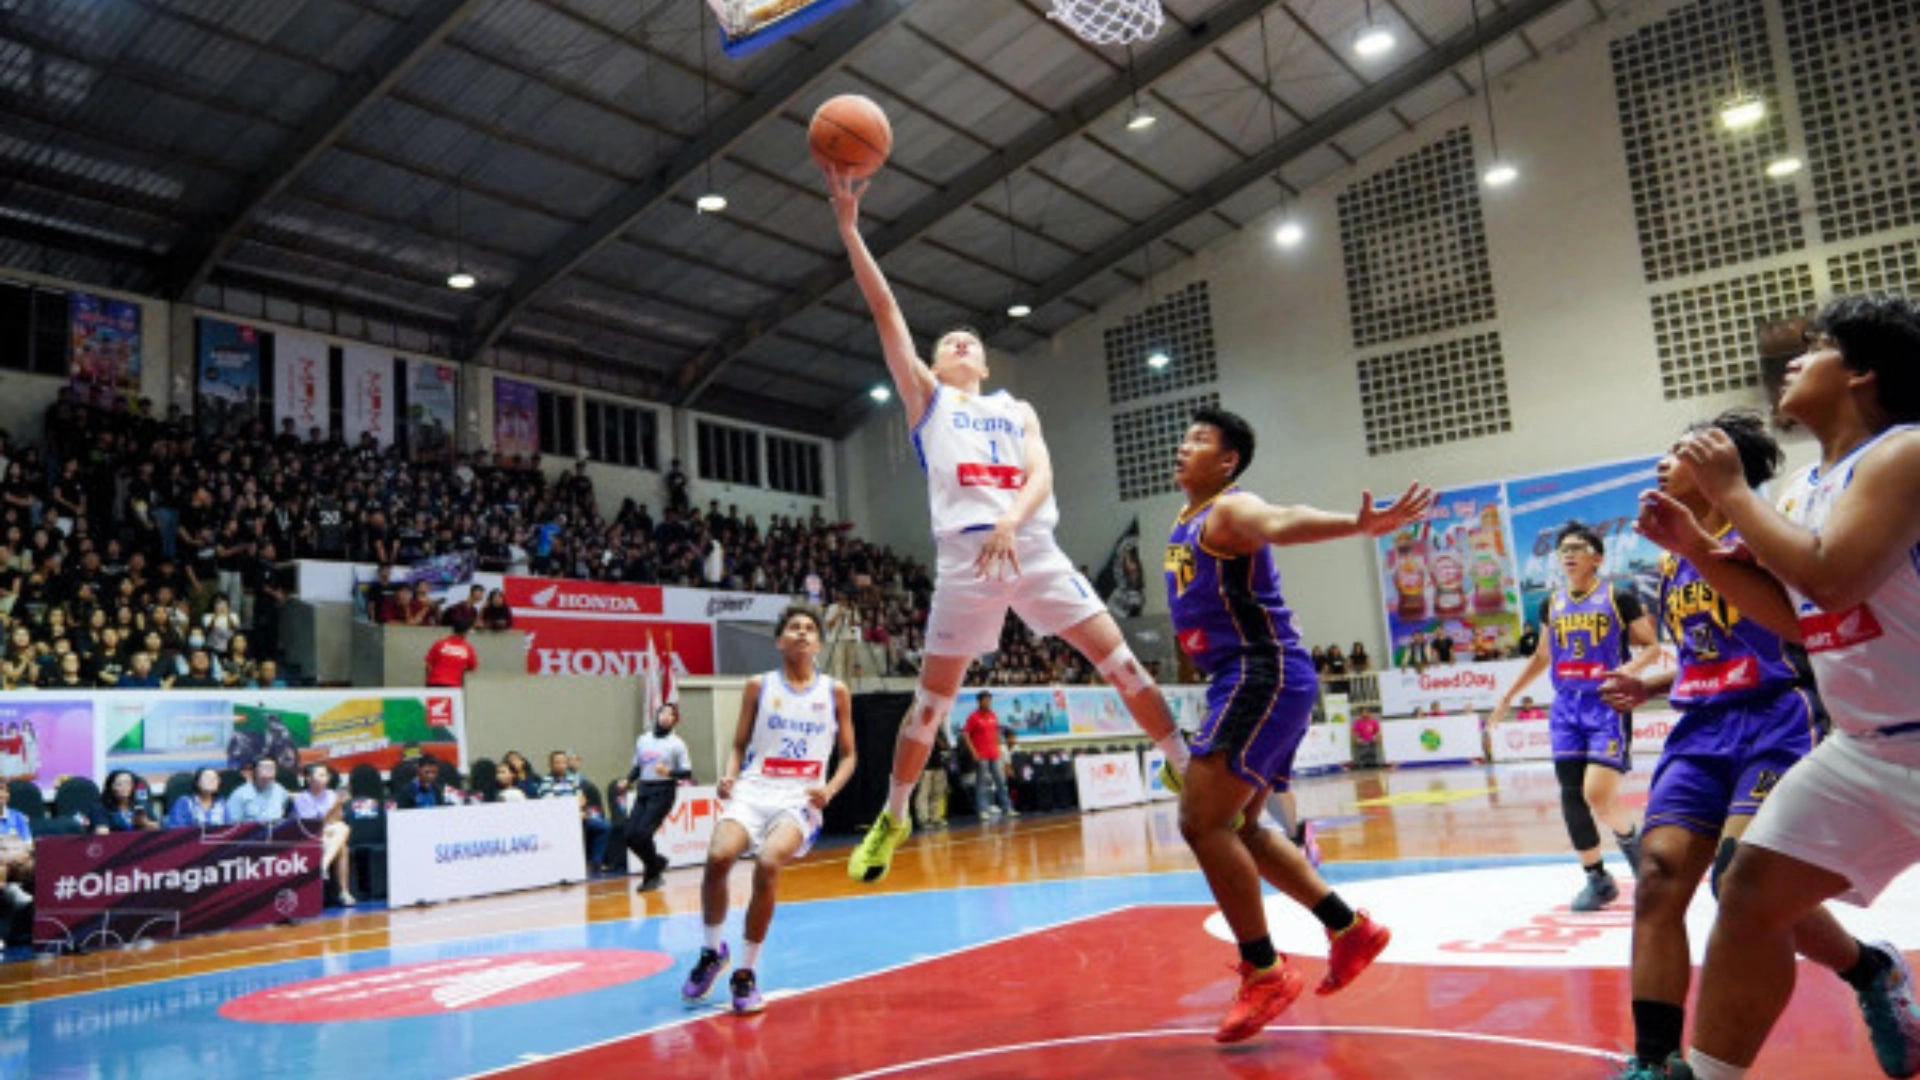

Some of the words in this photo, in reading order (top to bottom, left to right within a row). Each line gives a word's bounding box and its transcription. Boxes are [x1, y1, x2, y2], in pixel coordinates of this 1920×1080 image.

[989, 440, 1000, 464] 1
[557, 593, 641, 612] HONDA
[54, 853, 310, 901] #OlahragaTikTok
